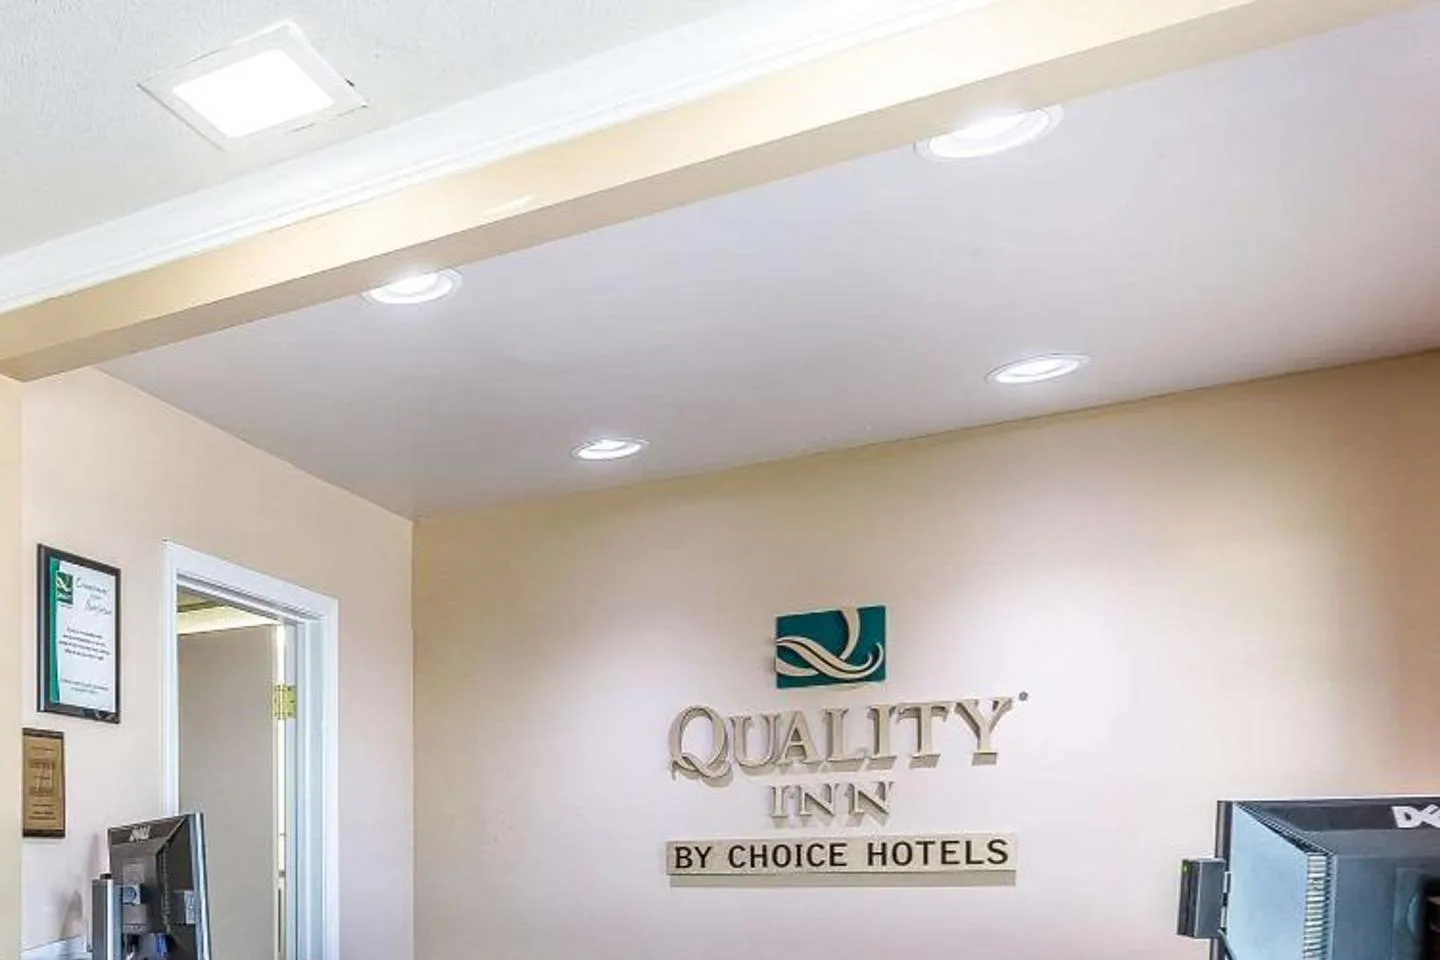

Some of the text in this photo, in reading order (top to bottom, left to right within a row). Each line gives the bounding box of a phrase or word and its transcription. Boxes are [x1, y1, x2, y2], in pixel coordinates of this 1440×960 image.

[668, 697, 1016, 778] QUALITY
[771, 781, 894, 819] INN
[674, 839, 1009, 869] BY CHOICE HOTELS
